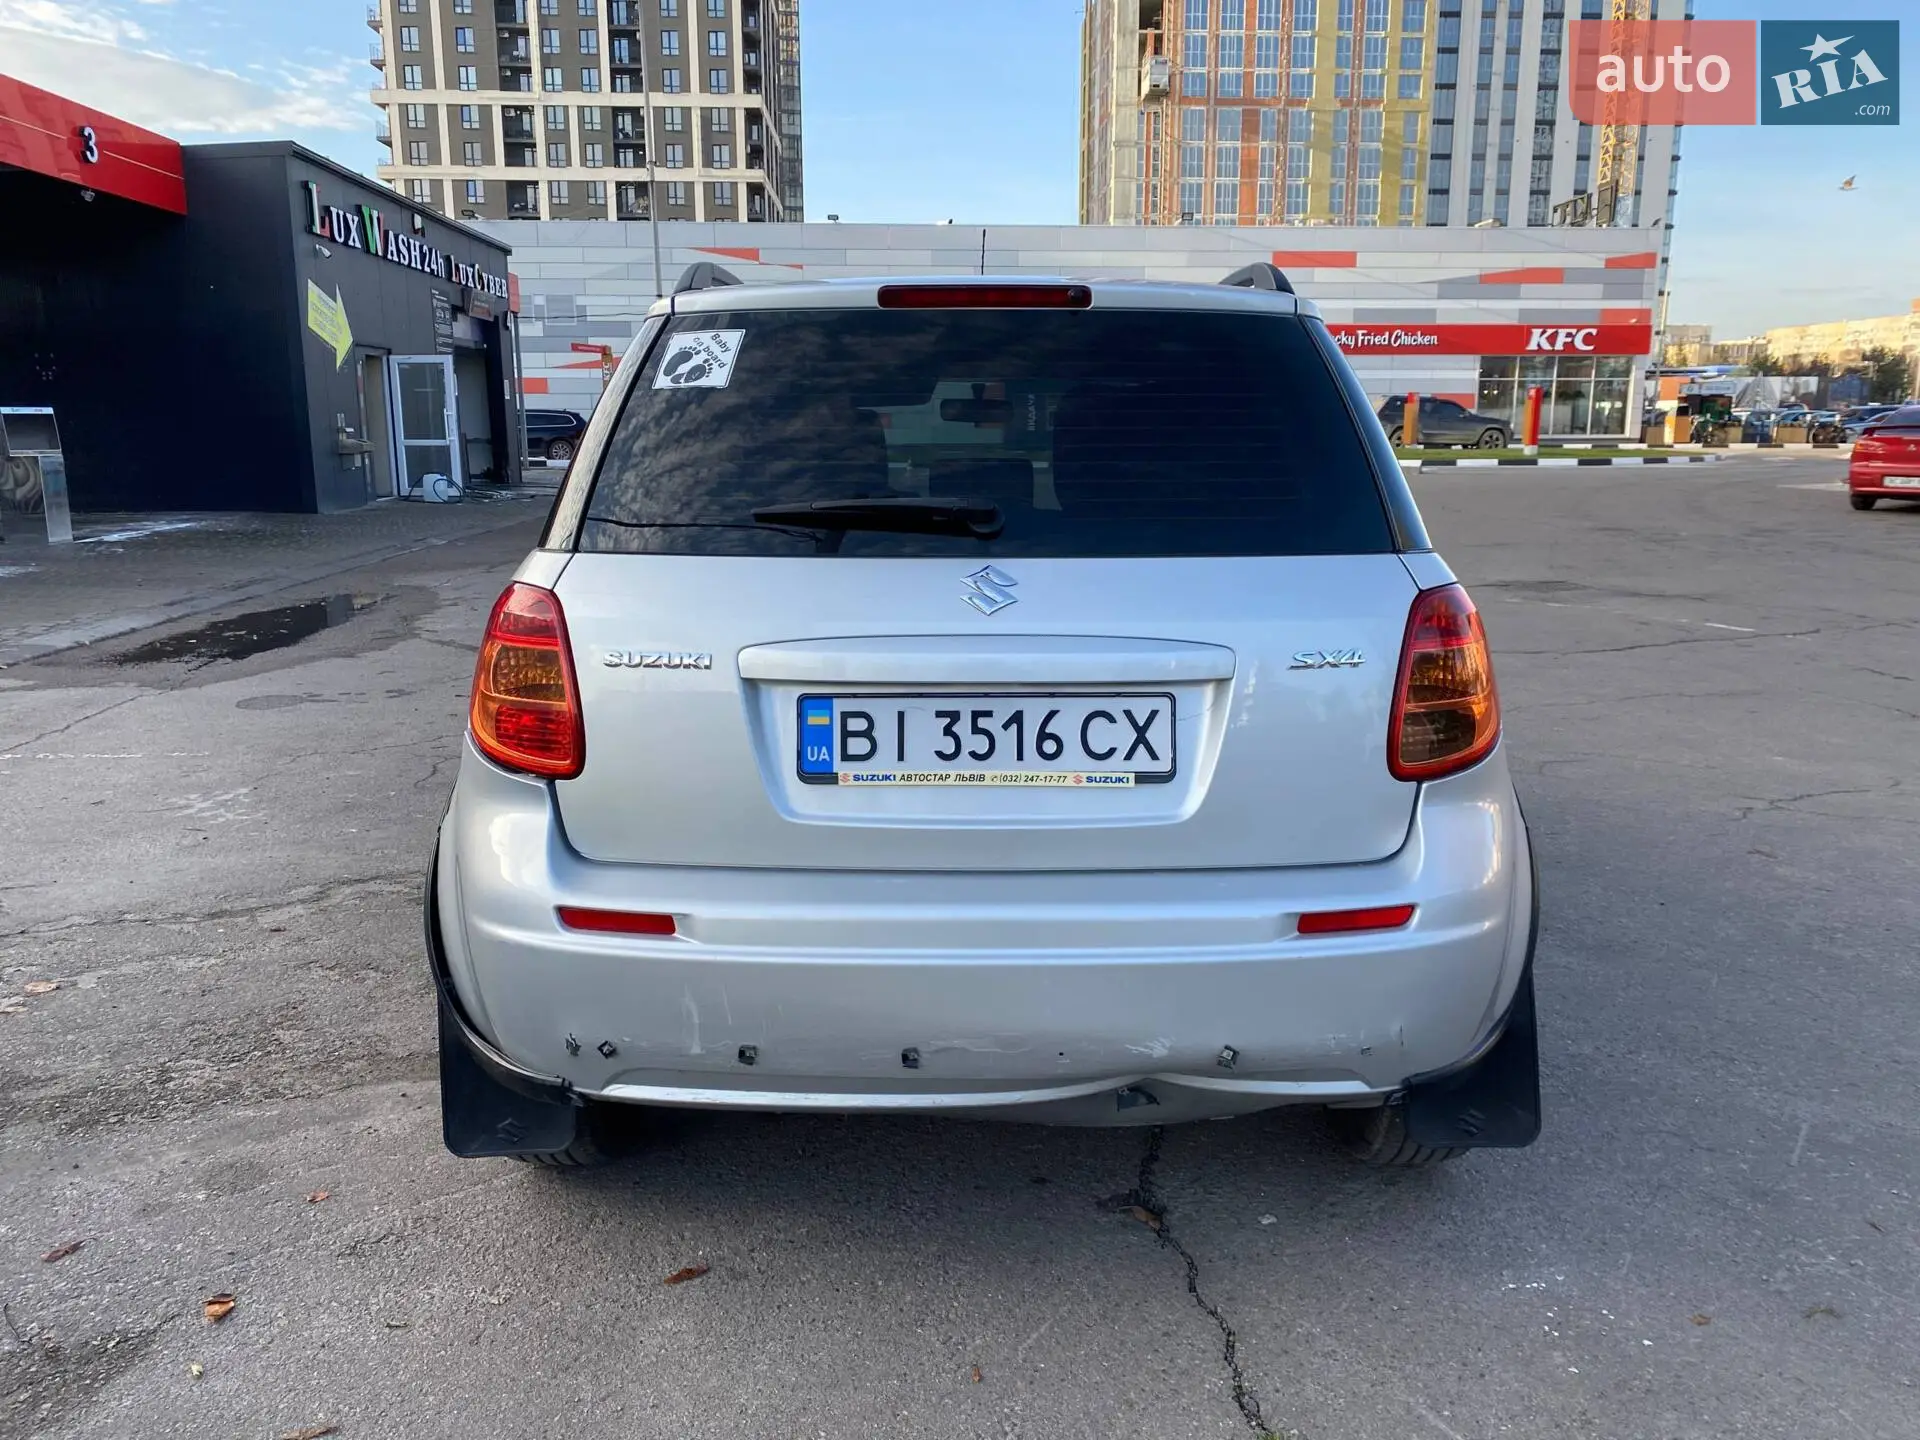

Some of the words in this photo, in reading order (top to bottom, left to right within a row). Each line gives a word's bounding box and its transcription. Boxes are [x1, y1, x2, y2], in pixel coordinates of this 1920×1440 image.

[80, 126, 99, 164] 3
[710, 333, 732, 353] Baby
[1356, 329, 1389, 348] Fried
[1390, 329, 1438, 347] Chicken
[1525, 328, 1599, 351] KFC
[703, 345, 728, 369] board
[603, 650, 713, 670] SUZUKI
[1287, 648, 1366, 670] SX4
[839, 710, 906, 762] BI
[933, 709, 1064, 762] 3516
[1080, 709, 1161, 762] CX
[807, 745, 831, 762] UA
[852, 774, 896, 782] SUZUKI
[899, 773, 951, 782] АВТОСТАР
[953, 773, 986, 782] ЛЬВІВ
[1000, 773, 1022, 783] (032)
[1023, 774, 1068, 784] 247-17-77
[1086, 775, 1130, 784] SUZUKI
